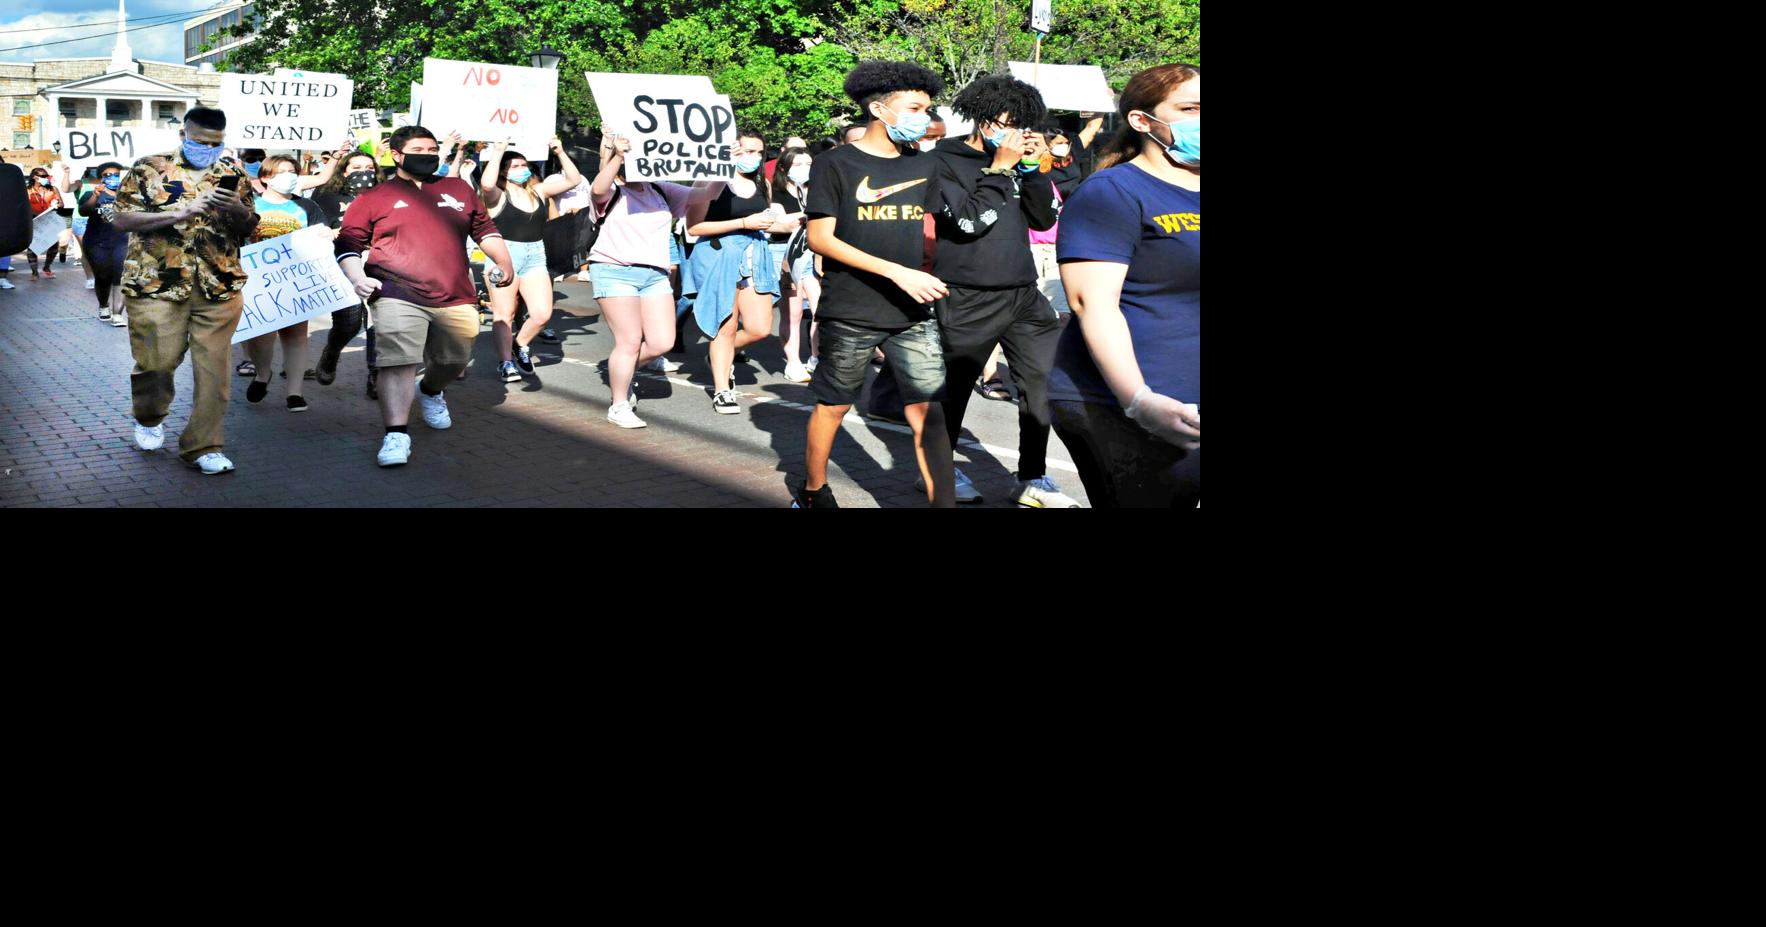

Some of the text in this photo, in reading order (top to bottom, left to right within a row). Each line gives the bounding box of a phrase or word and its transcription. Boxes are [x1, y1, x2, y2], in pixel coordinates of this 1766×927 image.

[463, 67, 501, 87] NO
[240, 80, 339, 98] UNITED
[262, 102, 302, 118] WE
[489, 108, 519, 124] NO
[632, 95, 733, 144] STOP
[242, 125, 323, 141] STAND
[69, 131, 135, 160] BLM
[643, 139, 732, 161] POLICE
[635, 158, 737, 179] BRUTALITY
[857, 205, 898, 221] NIKE
